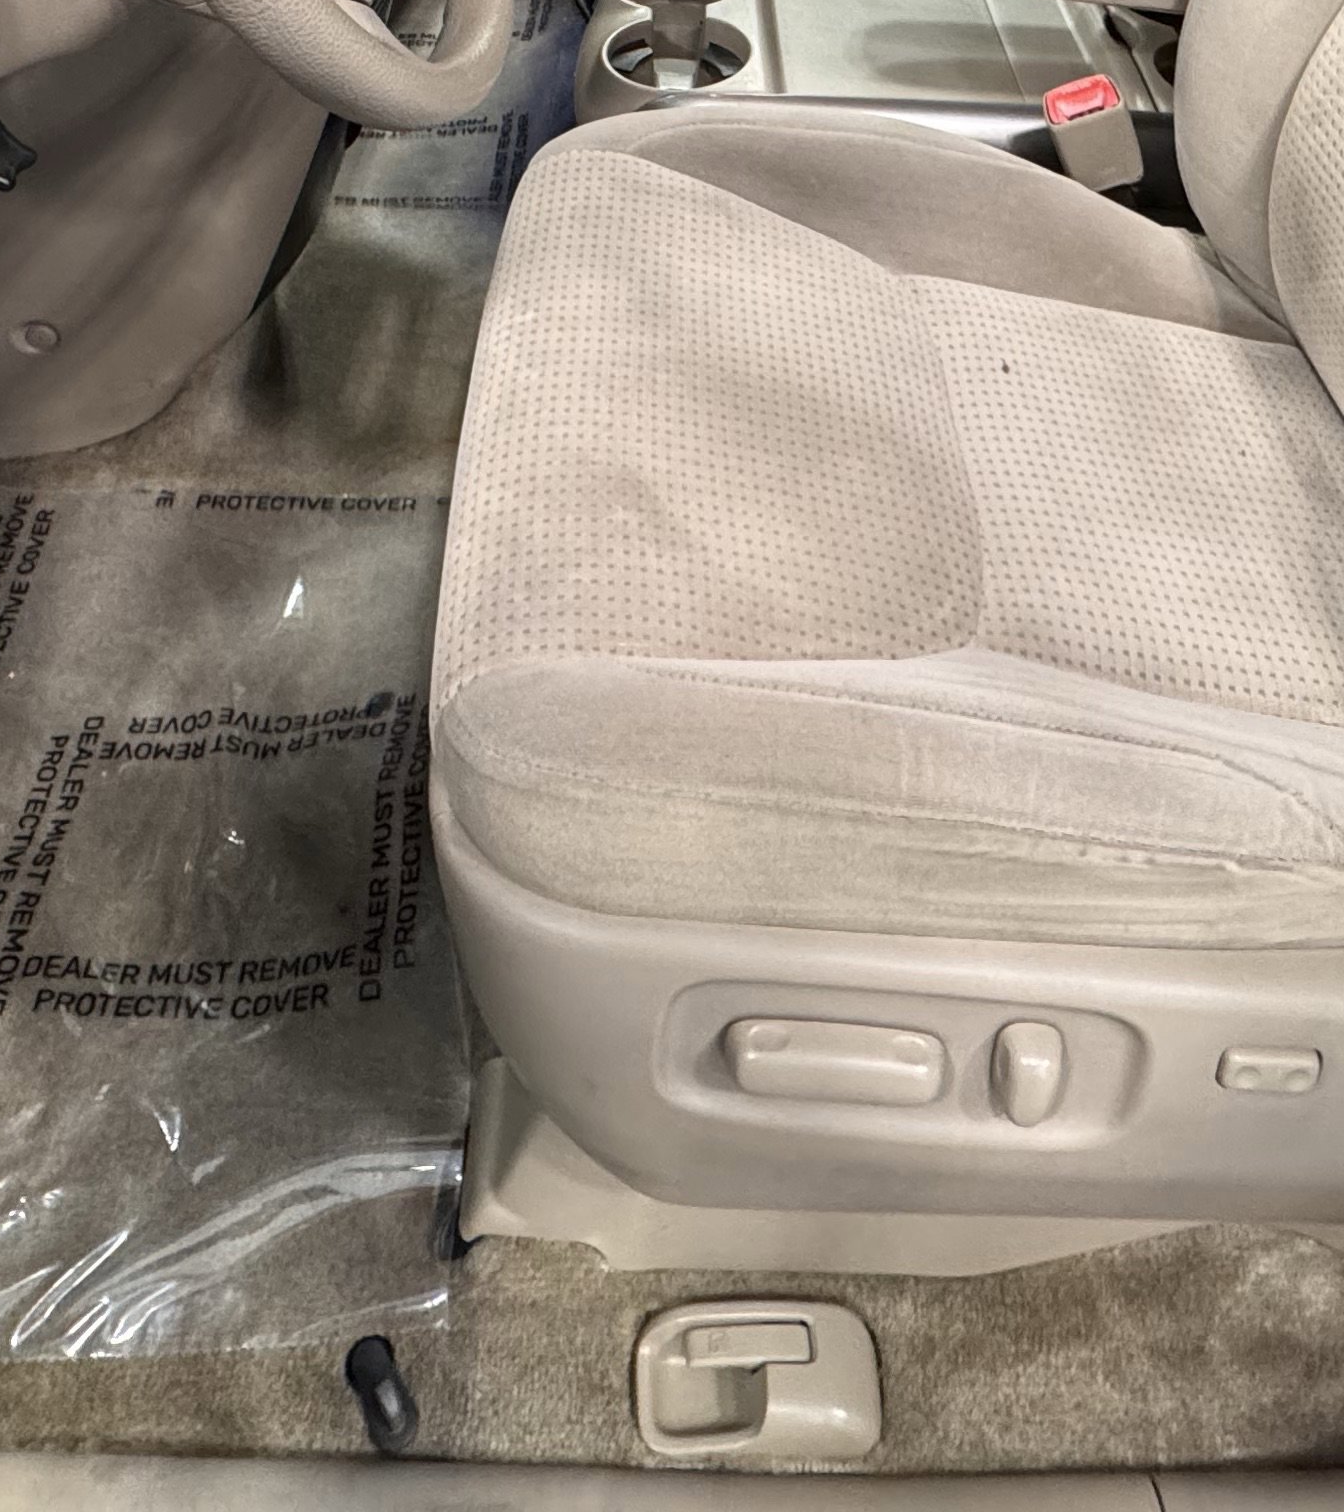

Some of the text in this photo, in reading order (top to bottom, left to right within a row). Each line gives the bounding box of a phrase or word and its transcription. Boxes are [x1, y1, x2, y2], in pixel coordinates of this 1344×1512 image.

[196, 494, 417, 512] PROTECTIVE COVER
[16, 508, 56, 576] COVER
[99, 721, 386, 761] DEALER MUST REMOVE
[128, 709, 213, 735] COVER
[58, 715, 105, 812] DEALER
[27, 818, 75, 887] MUST
[359, 693, 417, 1002] DEALER MUST REMOVE
[394, 780, 425, 969] PROTECTIVE
[21, 944, 358, 986] DEALER MUST REMOVE
[31, 983, 331, 1020] PROTECTIVE COVER
